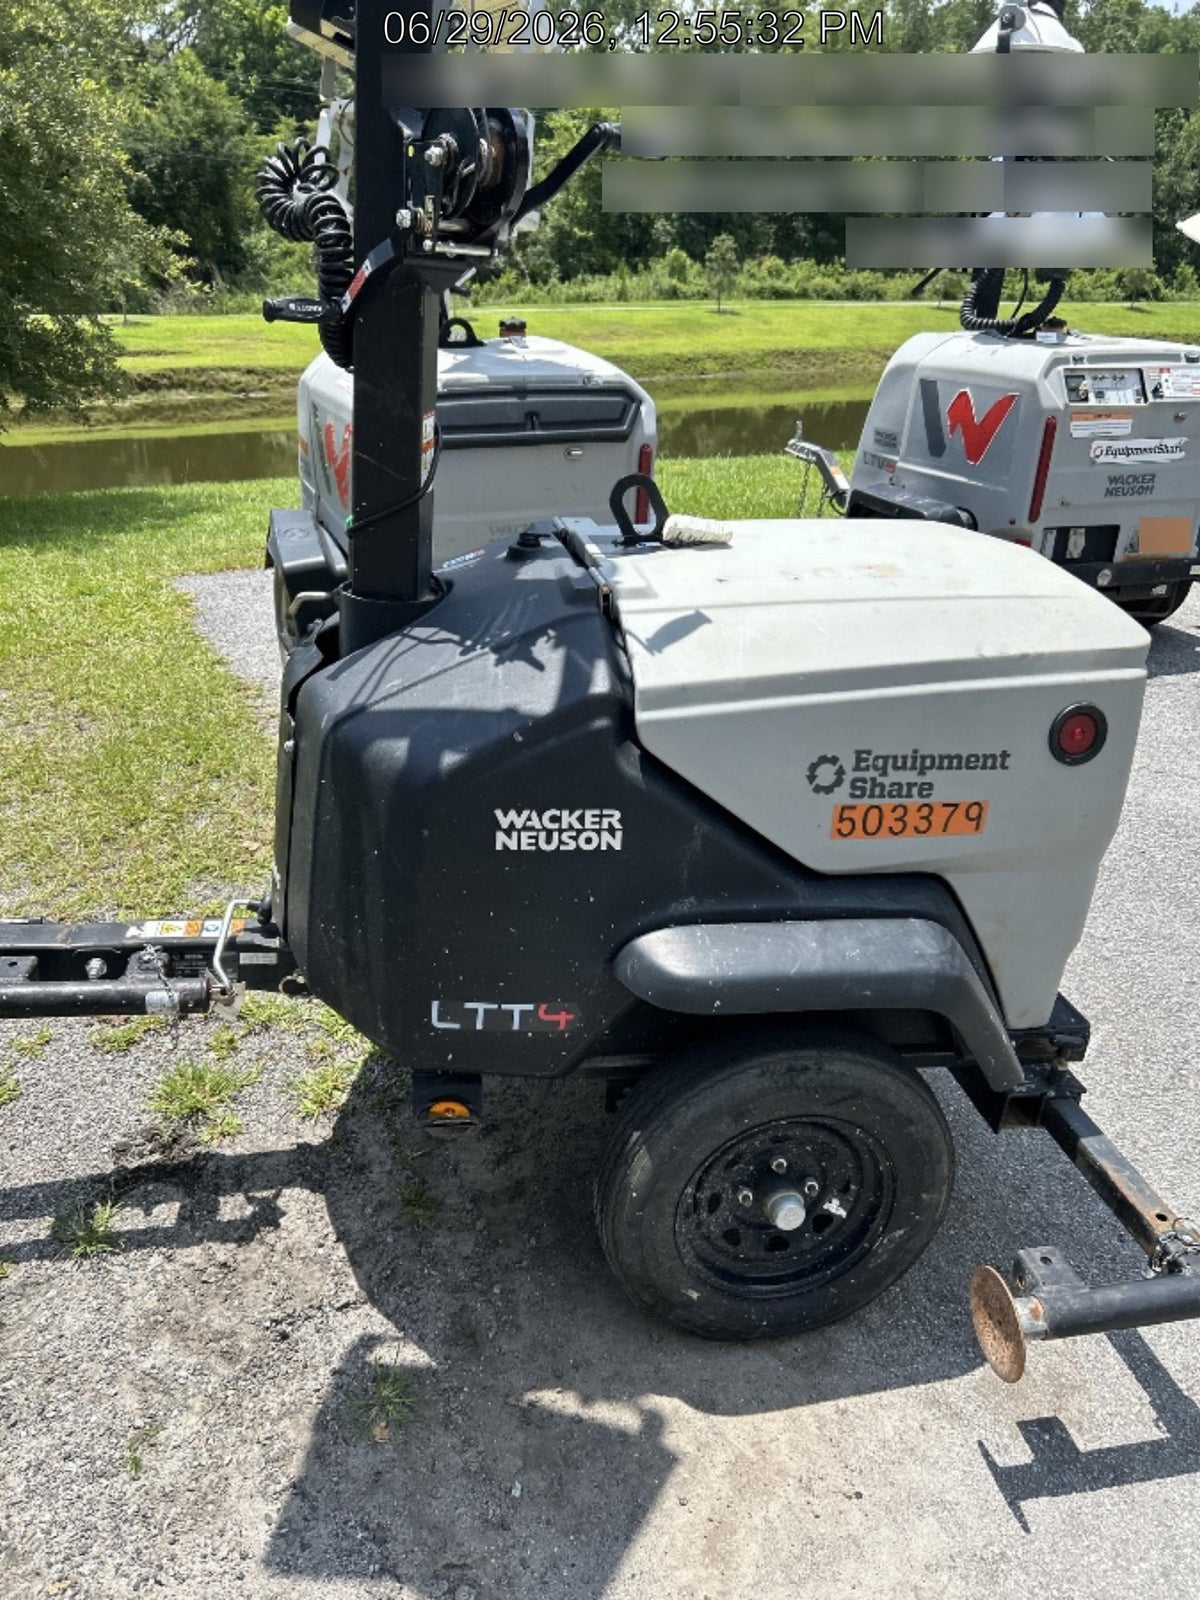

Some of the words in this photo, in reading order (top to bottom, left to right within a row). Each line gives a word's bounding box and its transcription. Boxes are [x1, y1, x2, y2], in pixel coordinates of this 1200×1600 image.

[1105, 444, 1184, 458] EquipmentShar
[1107, 473, 1156, 486] WACKER
[1104, 485, 1155, 498] NEUSON
[852, 749, 1011, 777] Equipment
[849, 777, 934, 799] Share
[493, 808, 623, 829] WACKER
[836, 801, 985, 838] 503379
[495, 830, 623, 851] NEUSON
[431, 1000, 576, 1031] LTT4
